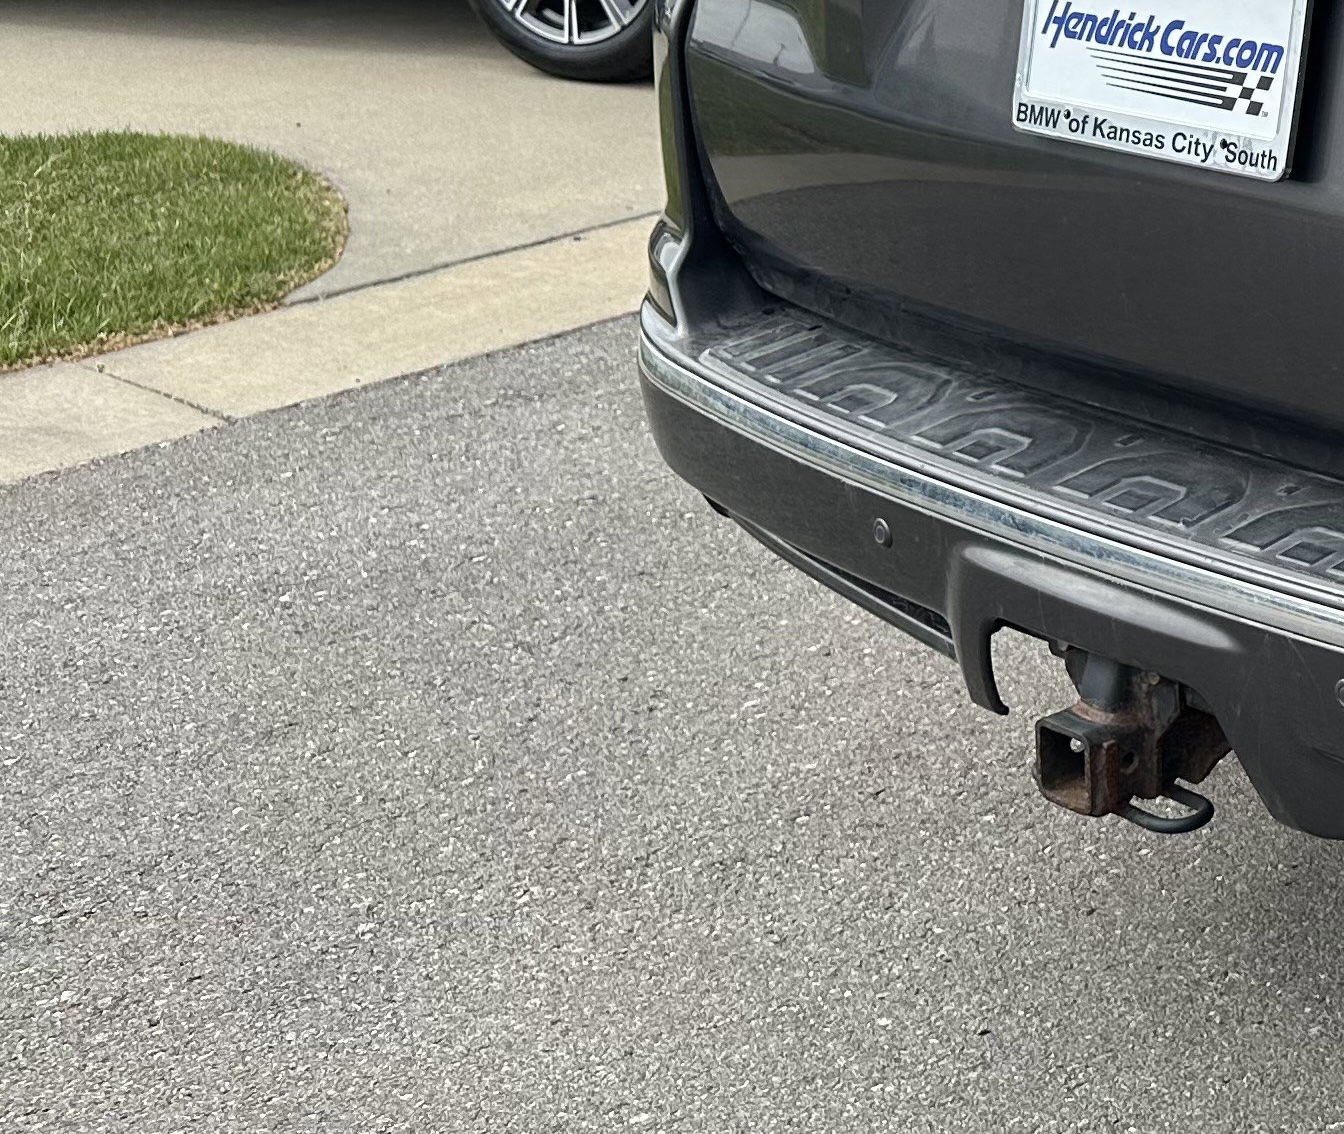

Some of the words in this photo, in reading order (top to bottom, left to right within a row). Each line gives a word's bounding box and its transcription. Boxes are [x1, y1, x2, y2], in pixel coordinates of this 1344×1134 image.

[1016, 102, 1061, 130] BMW
[1068, 115, 1089, 134] of
[1092, 118, 1165, 150] Kansas
[1171, 132, 1214, 163] City
[1224, 141, 1278, 171] South
